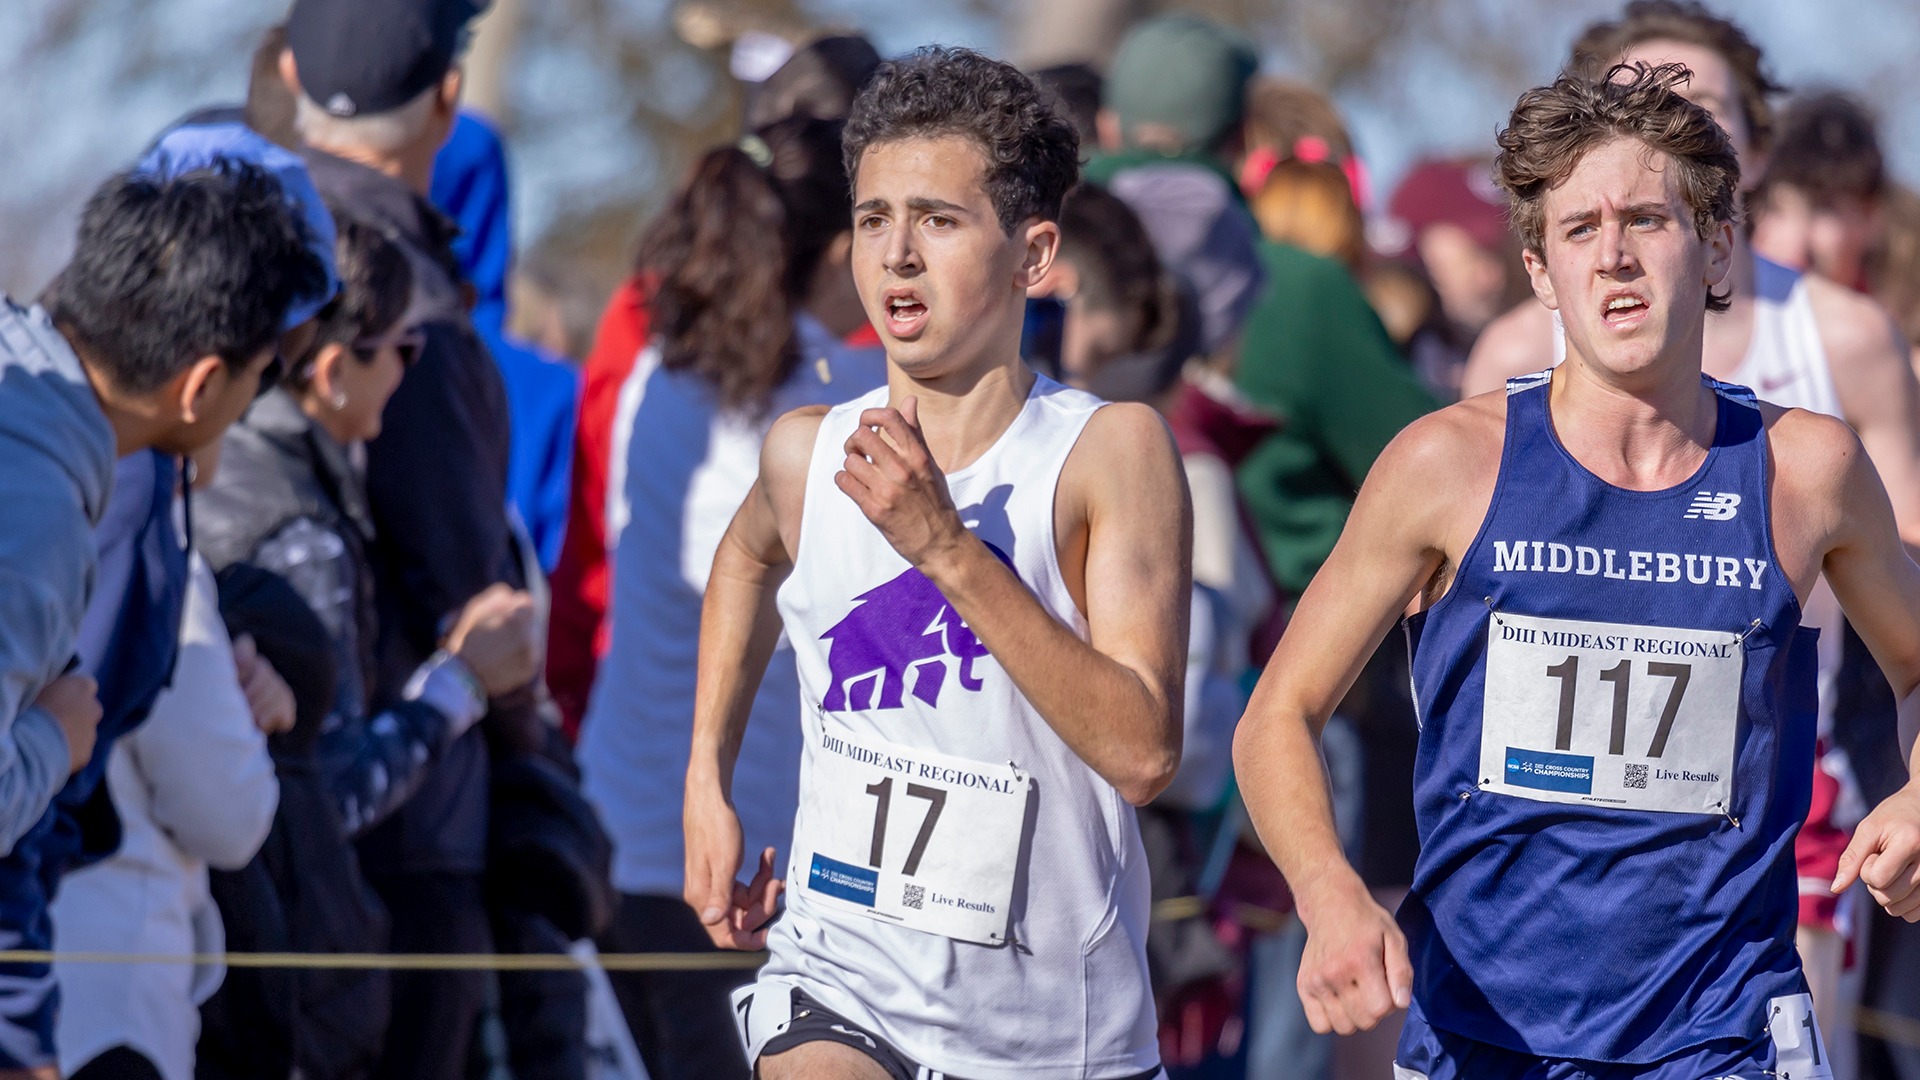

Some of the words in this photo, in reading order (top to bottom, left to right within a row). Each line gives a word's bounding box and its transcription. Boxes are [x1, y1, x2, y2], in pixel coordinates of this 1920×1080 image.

[1493, 540, 1767, 590] MIDDLEBURY
[1502, 625, 1536, 644] DIII
[1541, 631, 1628, 651] MIDEAST
[1633, 639, 1732, 659] REGIONAL
[1546, 655, 1692, 758] 117
[822, 734, 844, 755] DIII
[846, 743, 916, 774] MIDEAST
[919, 763, 1015, 795] REGIONAL
[1533, 768, 1590, 780] CHAMPIONSHIPS
[1545, 764, 1563, 772] CROSS
[1655, 769, 1680, 781] Live
[1682, 770, 1720, 783] Results
[865, 776, 948, 877] 17
[830, 876, 875, 893] CHAMPIONSHIPS
[931, 893, 953, 907] Live
[956, 897, 996, 914] Results
